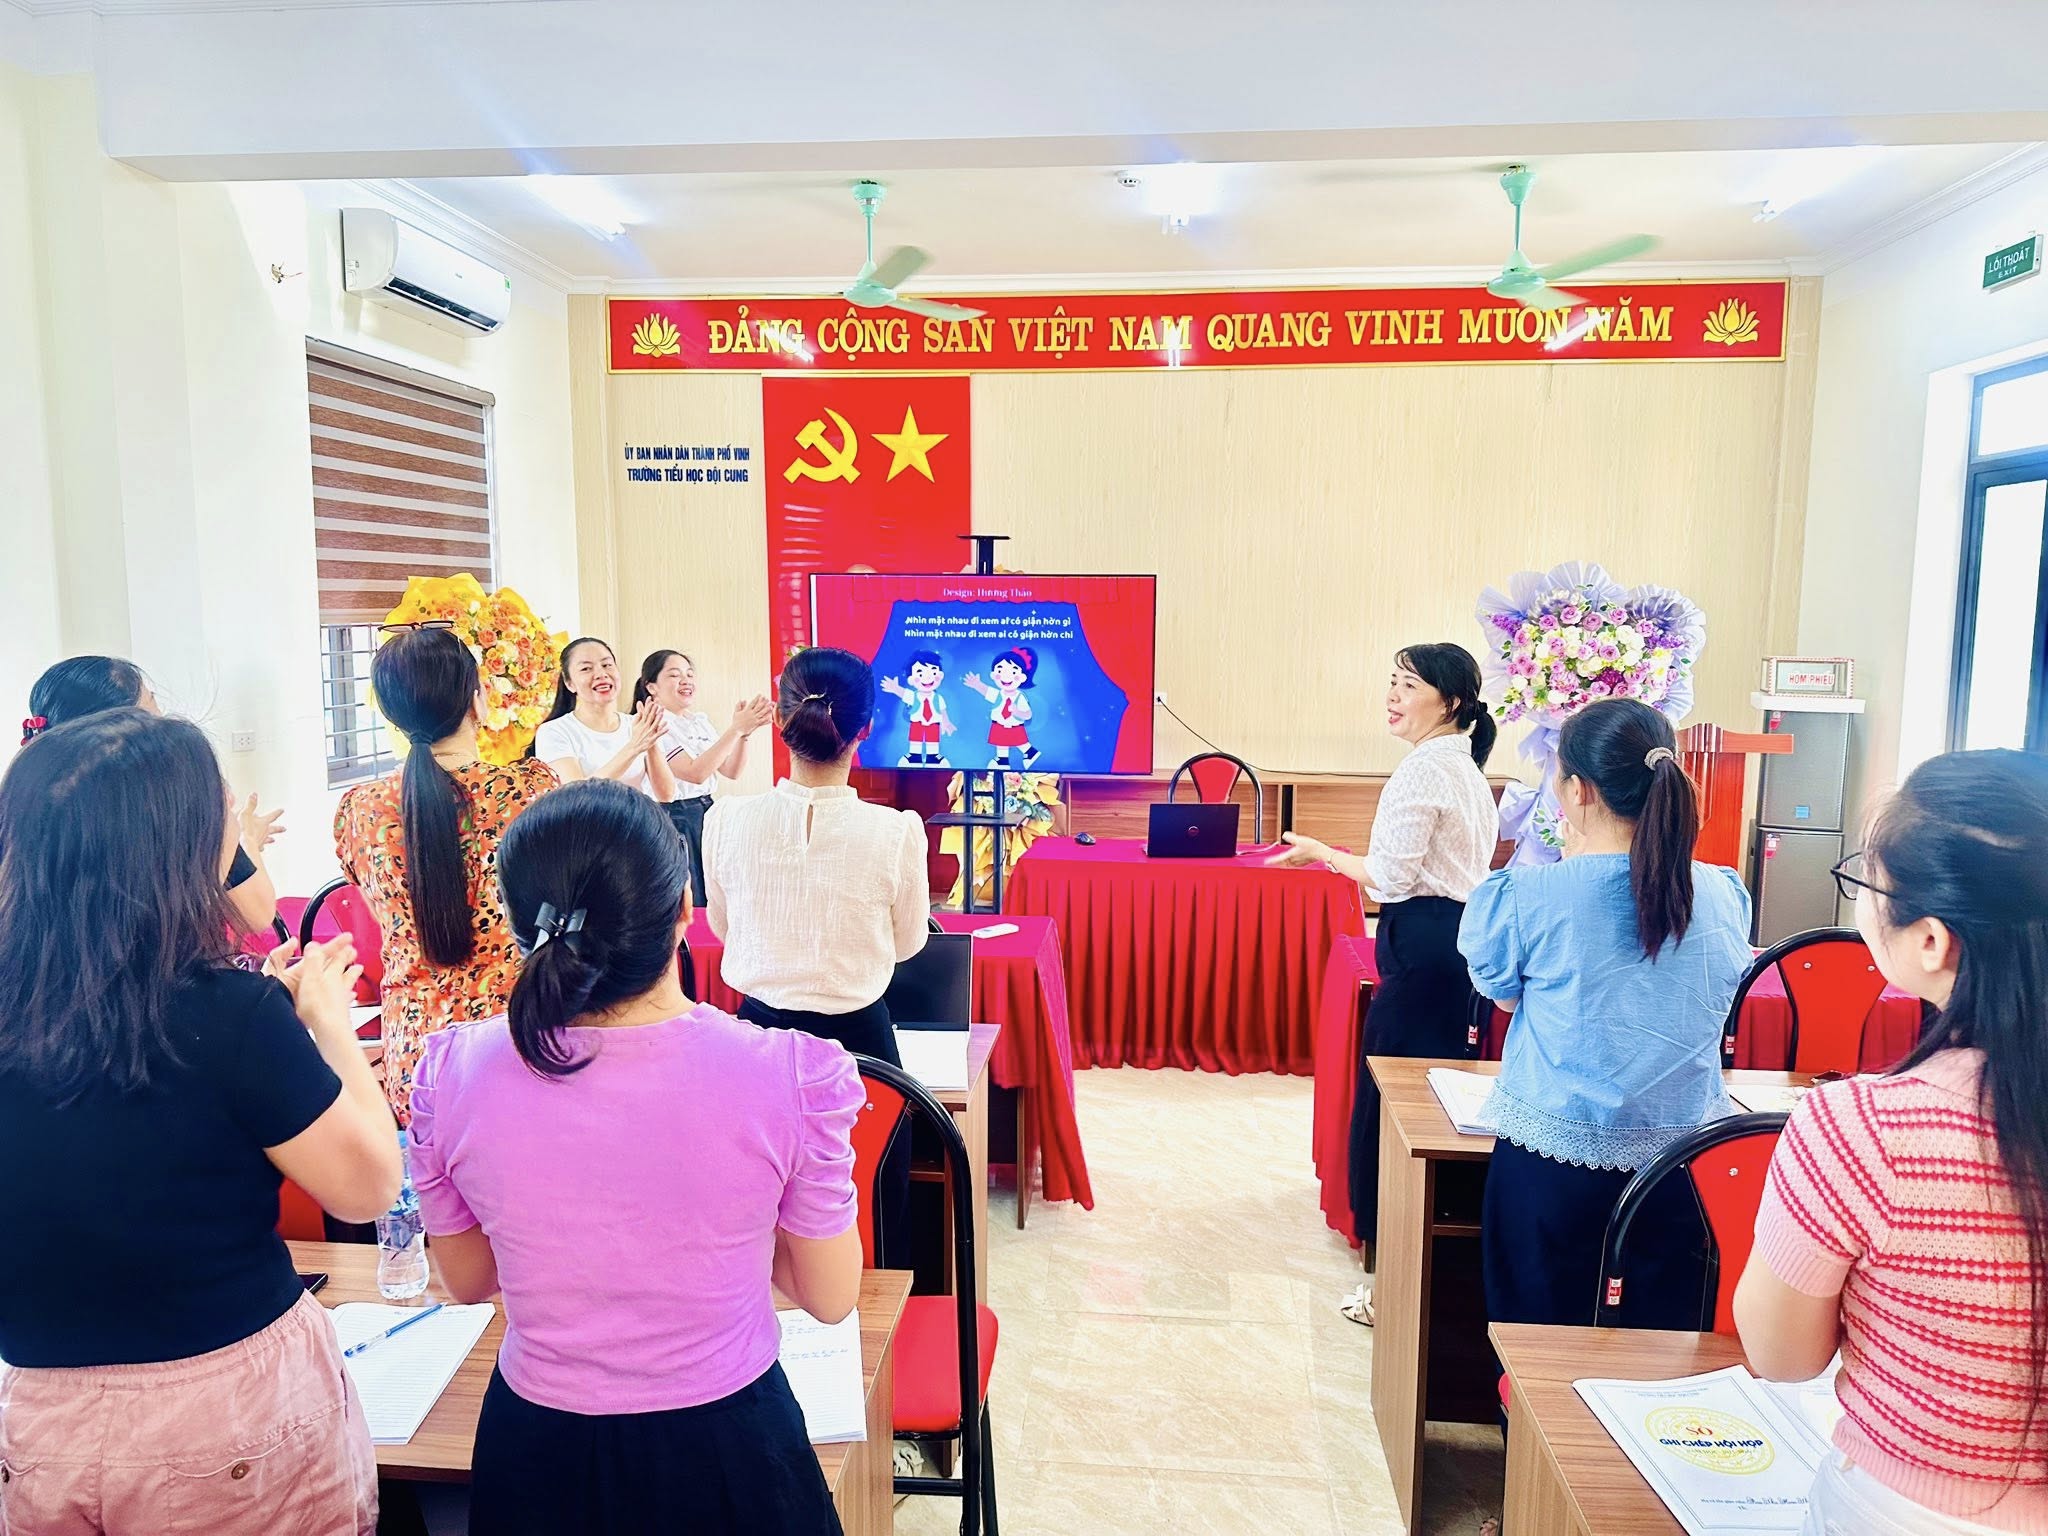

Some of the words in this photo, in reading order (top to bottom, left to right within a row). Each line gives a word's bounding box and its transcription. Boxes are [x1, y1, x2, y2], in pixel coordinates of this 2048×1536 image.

[1998, 265, 2018, 279] EXIT
[708, 304, 806, 354] ĐẢNG
[817, 307, 910, 362] CỘNG
[1008, 305, 1094, 360] VIỆT
[1109, 315, 1194, 351] NAM
[1206, 310, 1333, 353] QUANG
[1345, 308, 1444, 346] VINH
[1583, 296, 1675, 343] NĂM
[636, 446, 651, 460] BAN
[653, 444, 673, 460] NHÂN
[675, 444, 690, 460] DÂN
[717, 443, 731, 460] PHỐ
[733, 447, 750, 460] VINH
[627, 465, 662, 481] TRƯỜNG
[664, 463, 683, 482] TIỂU
[686, 469, 704, 485] HỌC
[706, 466, 722, 485] ĐỘI
[724, 469, 749, 482] CUNG
[905, 615, 927, 625] Nhìn
[928, 615, 946, 626] mặt
[947, 616, 969, 625] nhau
[970, 616, 979, 625] đi
[1010, 616, 1021, 625] có
[1022, 616, 1042, 627] giận
[1043, 616, 1061, 625] hờn
[904, 629, 925, 638] Nhìn
[926, 628, 943, 639] mặt
[944, 630, 967, 638] nhau
[968, 630, 977, 638] đi
[998, 630, 1007, 638] ai
[1008, 629, 1018, 638] có
[1020, 629, 1039, 640] giận
[1040, 630, 1058, 639] hờn
[1060, 630, 1074, 639] chi
[1659, 1438, 1681, 1446] GHI
[1714, 1439, 1737, 1449] HỘI
[1737, 1439, 1764, 1449] HỌP
